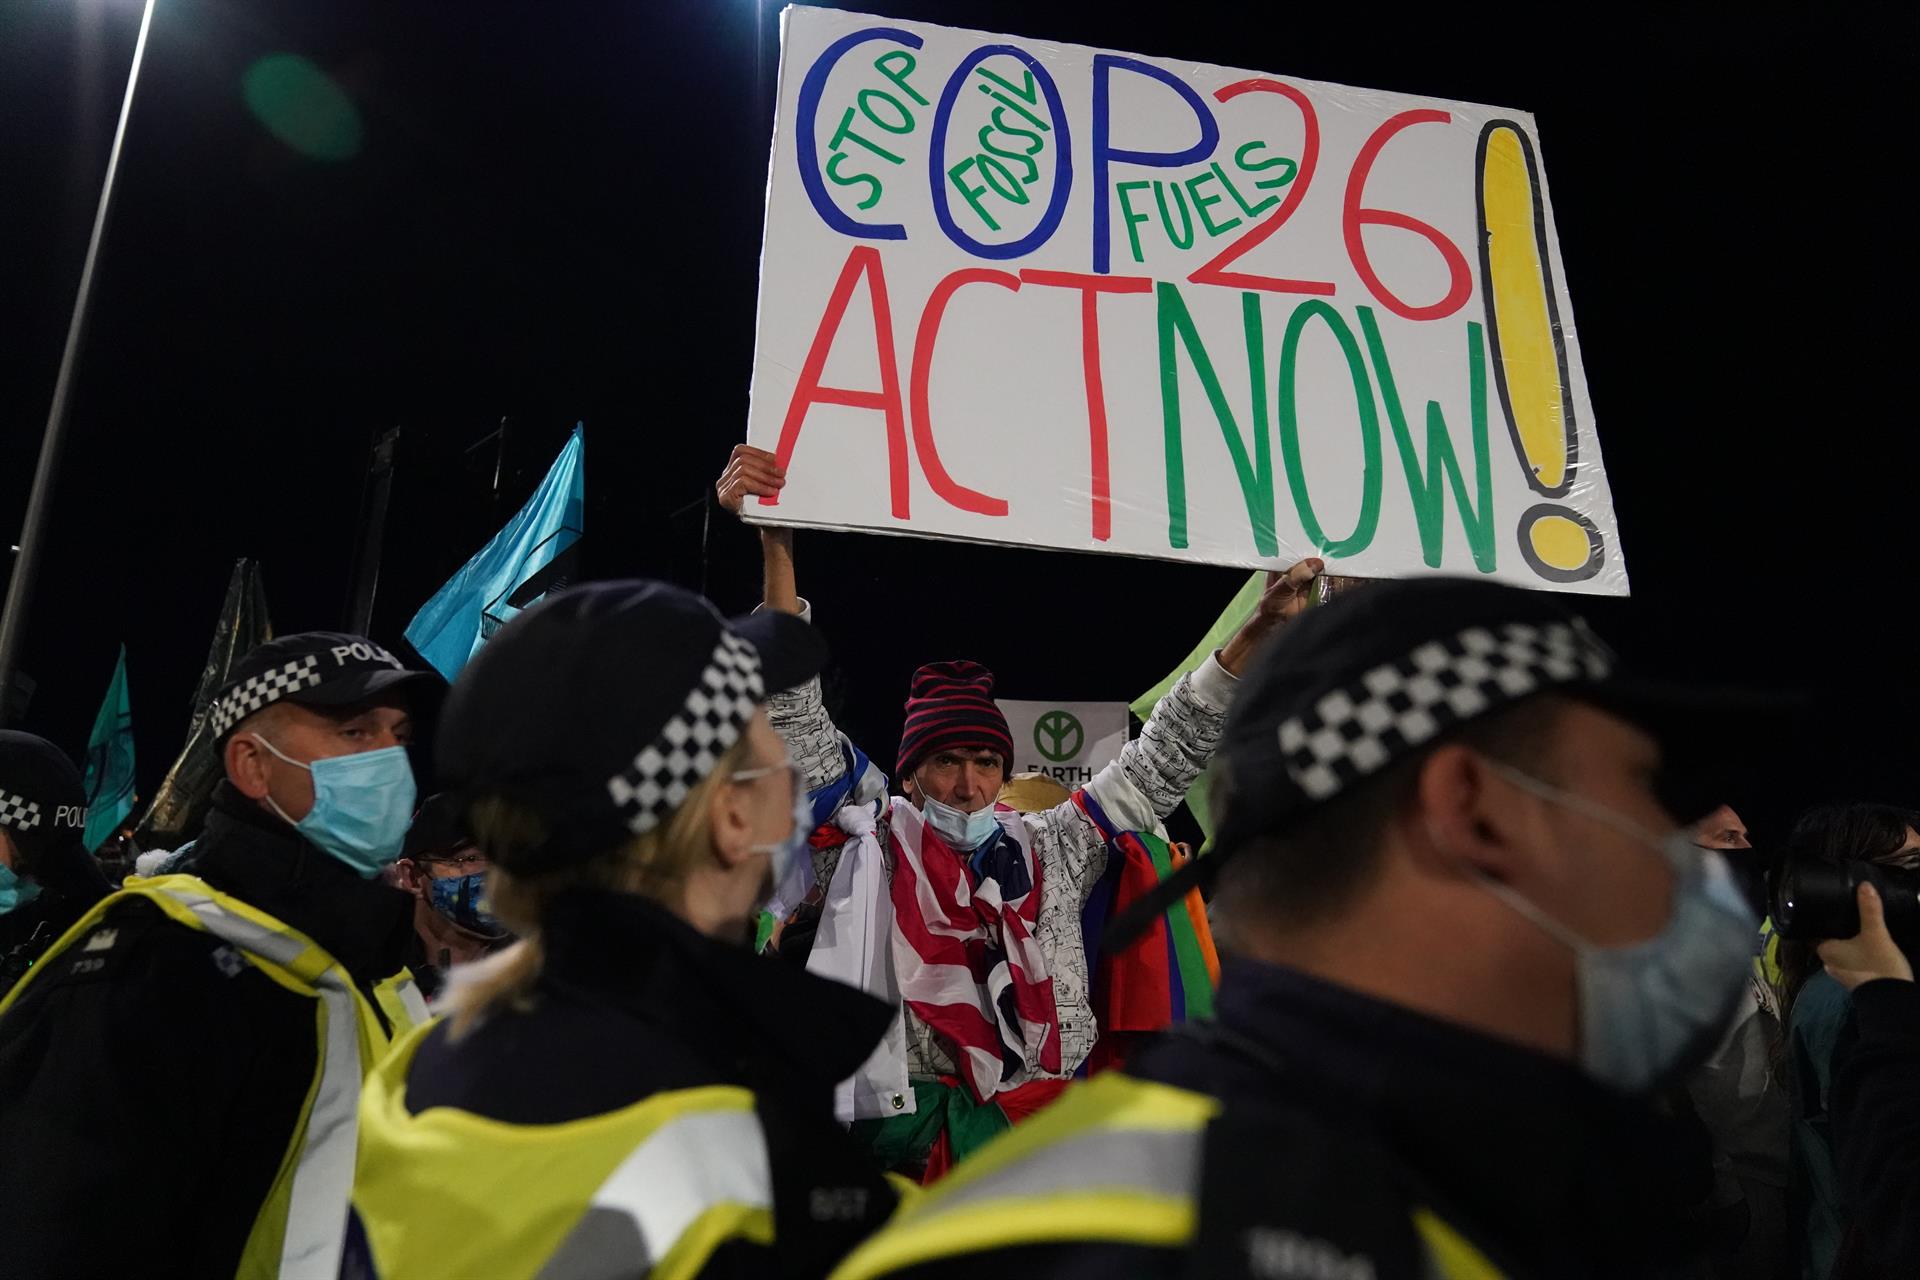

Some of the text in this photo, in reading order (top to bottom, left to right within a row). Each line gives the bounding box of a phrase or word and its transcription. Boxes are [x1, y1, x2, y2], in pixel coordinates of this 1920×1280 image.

[826, 50, 930, 210] STOP
[1116, 140, 1298, 263] FUELS
[758, 245, 1153, 541] ACT
